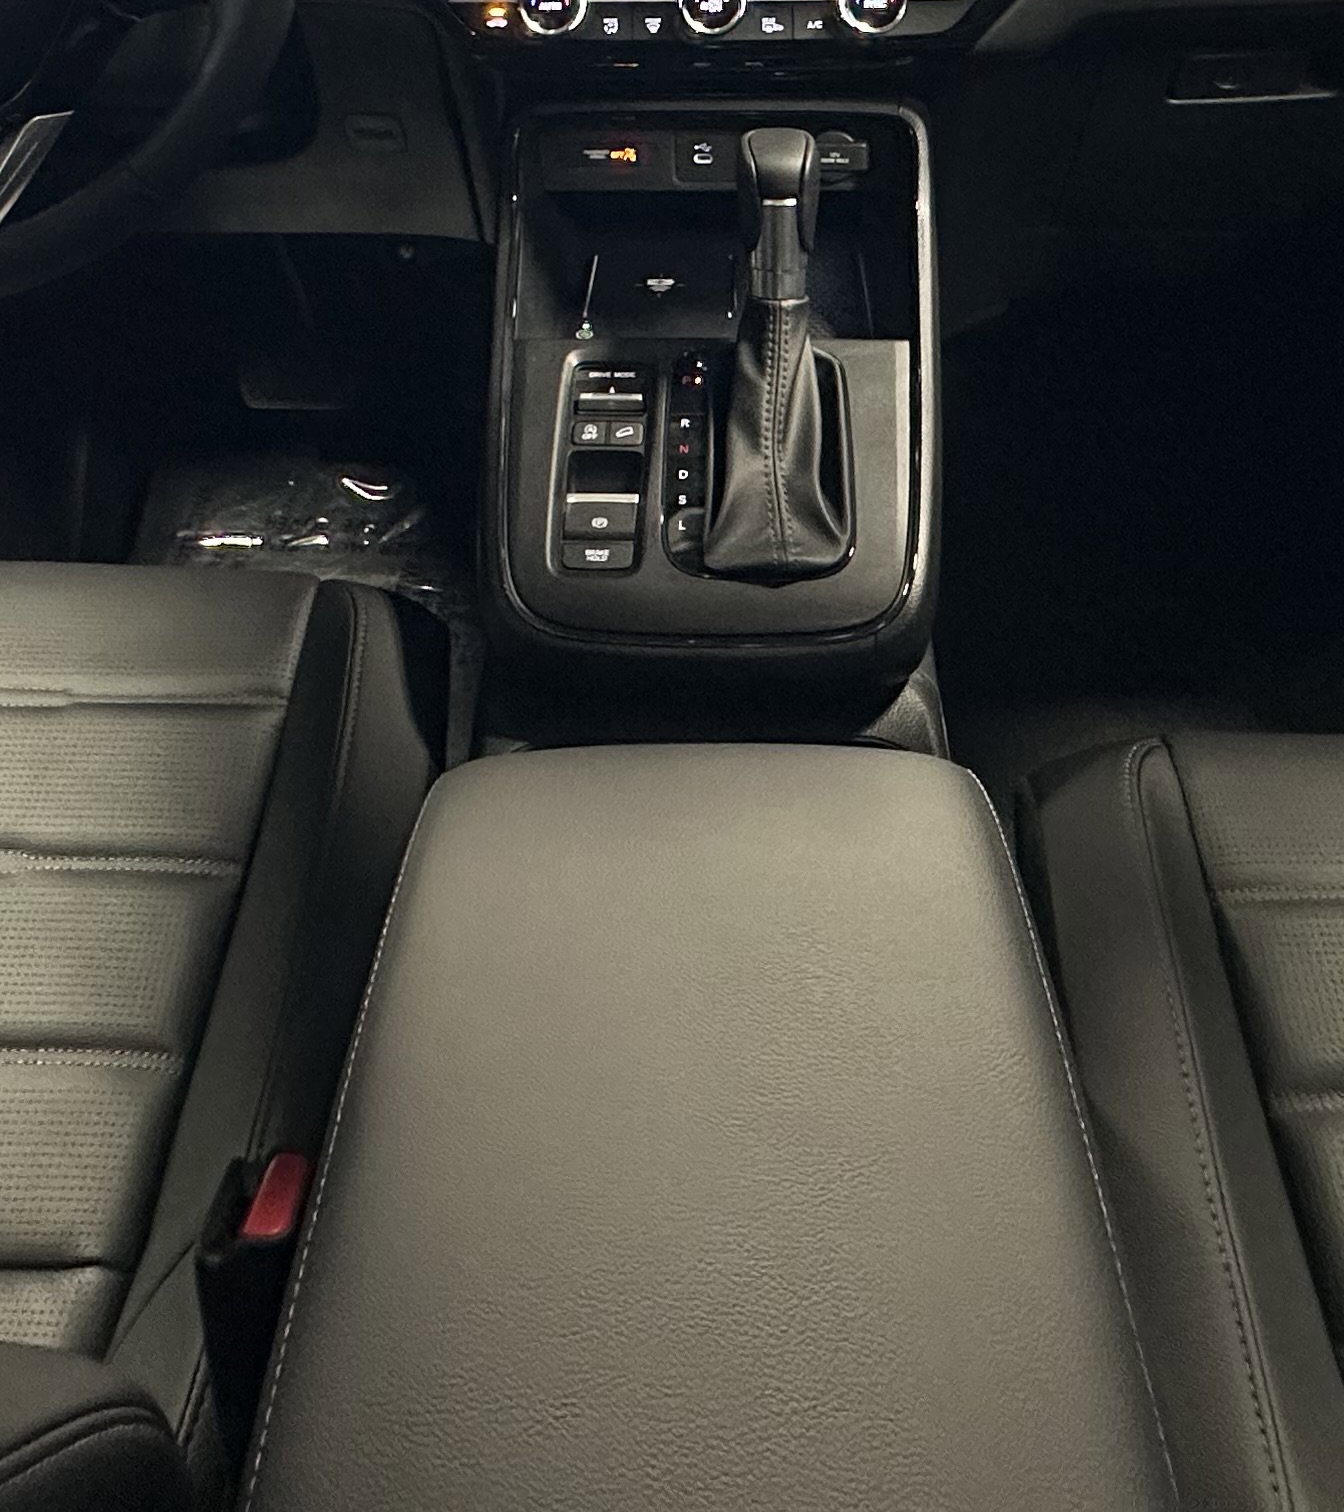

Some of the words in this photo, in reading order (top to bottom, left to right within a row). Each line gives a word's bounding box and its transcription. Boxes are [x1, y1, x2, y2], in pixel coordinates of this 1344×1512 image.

[806, 20, 823, 29] A/C
[682, 375, 690, 385] P
[680, 418, 691, 428] R
[679, 444, 689, 454] N
[678, 470, 689, 480] D
[678, 495, 687, 505] S
[678, 520, 686, 531] L
